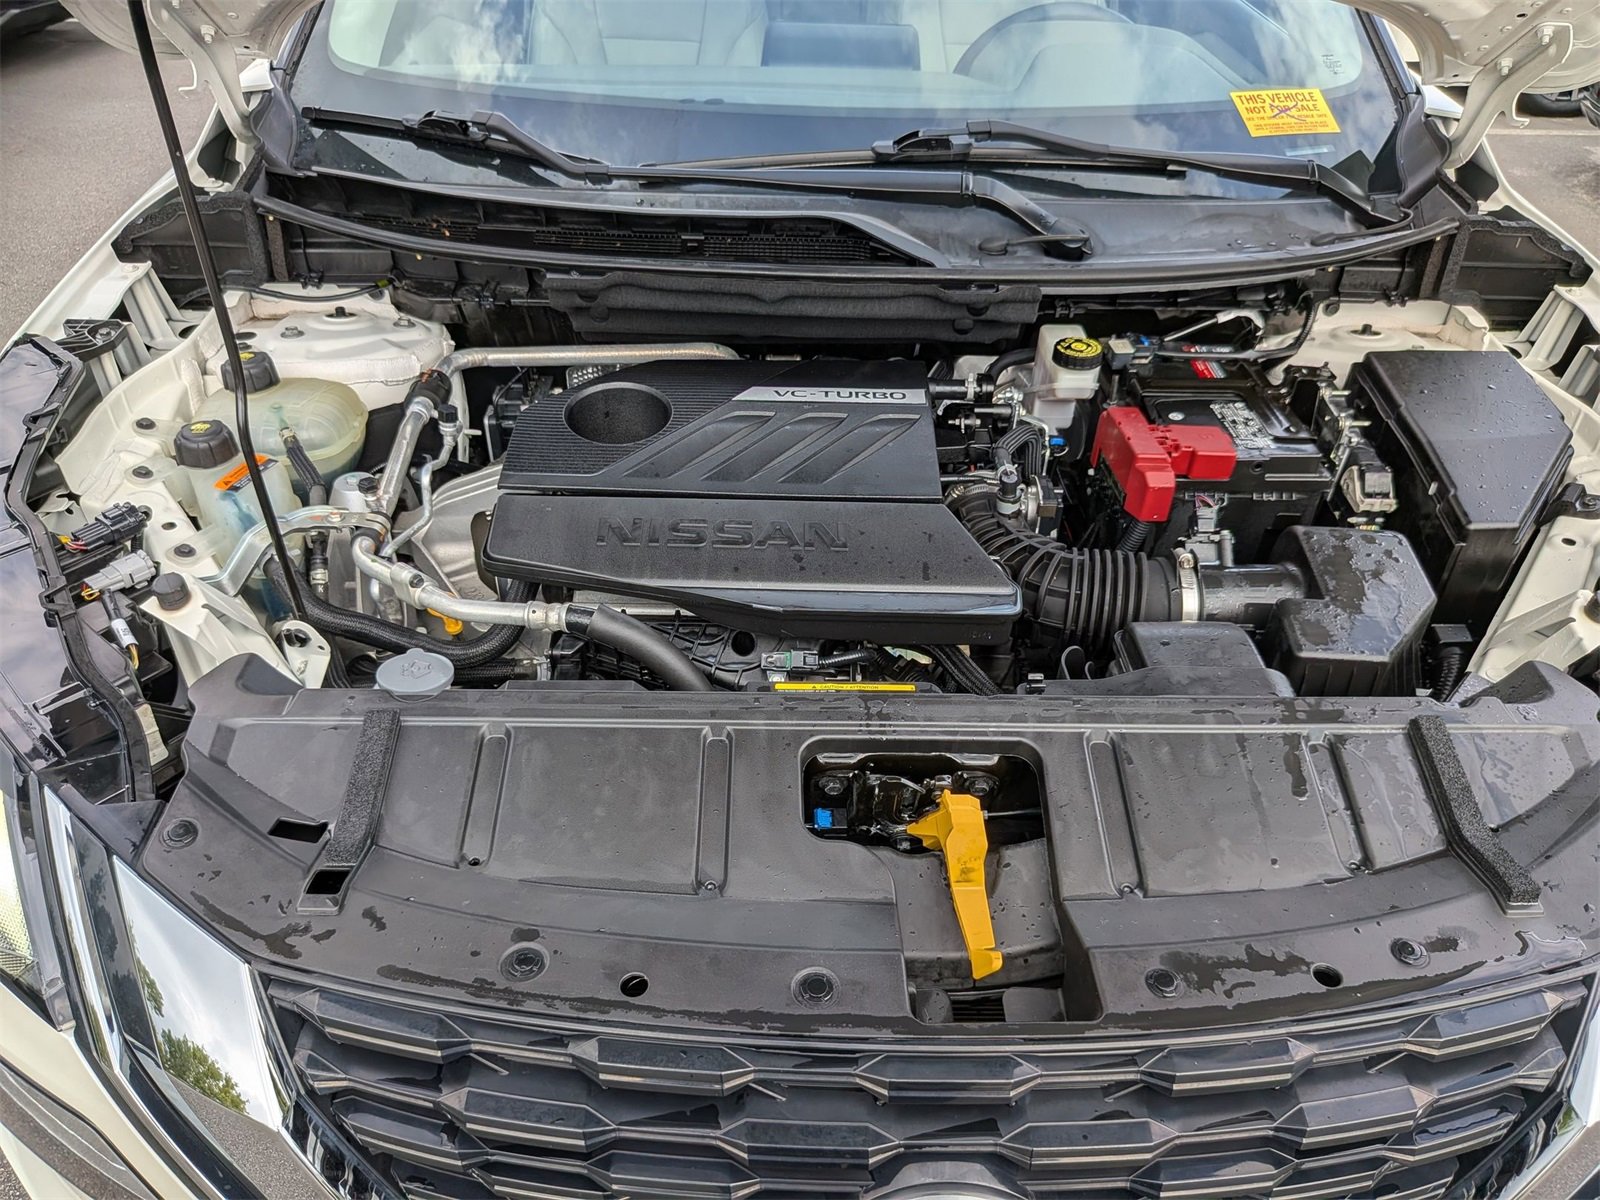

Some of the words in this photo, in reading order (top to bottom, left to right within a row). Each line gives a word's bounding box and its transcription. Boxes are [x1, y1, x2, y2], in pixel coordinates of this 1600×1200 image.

[1236, 94, 1266, 105] THIS
[1267, 92, 1317, 103] VEHICLE
[1245, 106, 1267, 115] NOT
[1269, 105, 1292, 114] FOR
[1295, 104, 1320, 113] SALE
[773, 389, 907, 400] VC-TURBO
[597, 518, 849, 551] NISSAN
